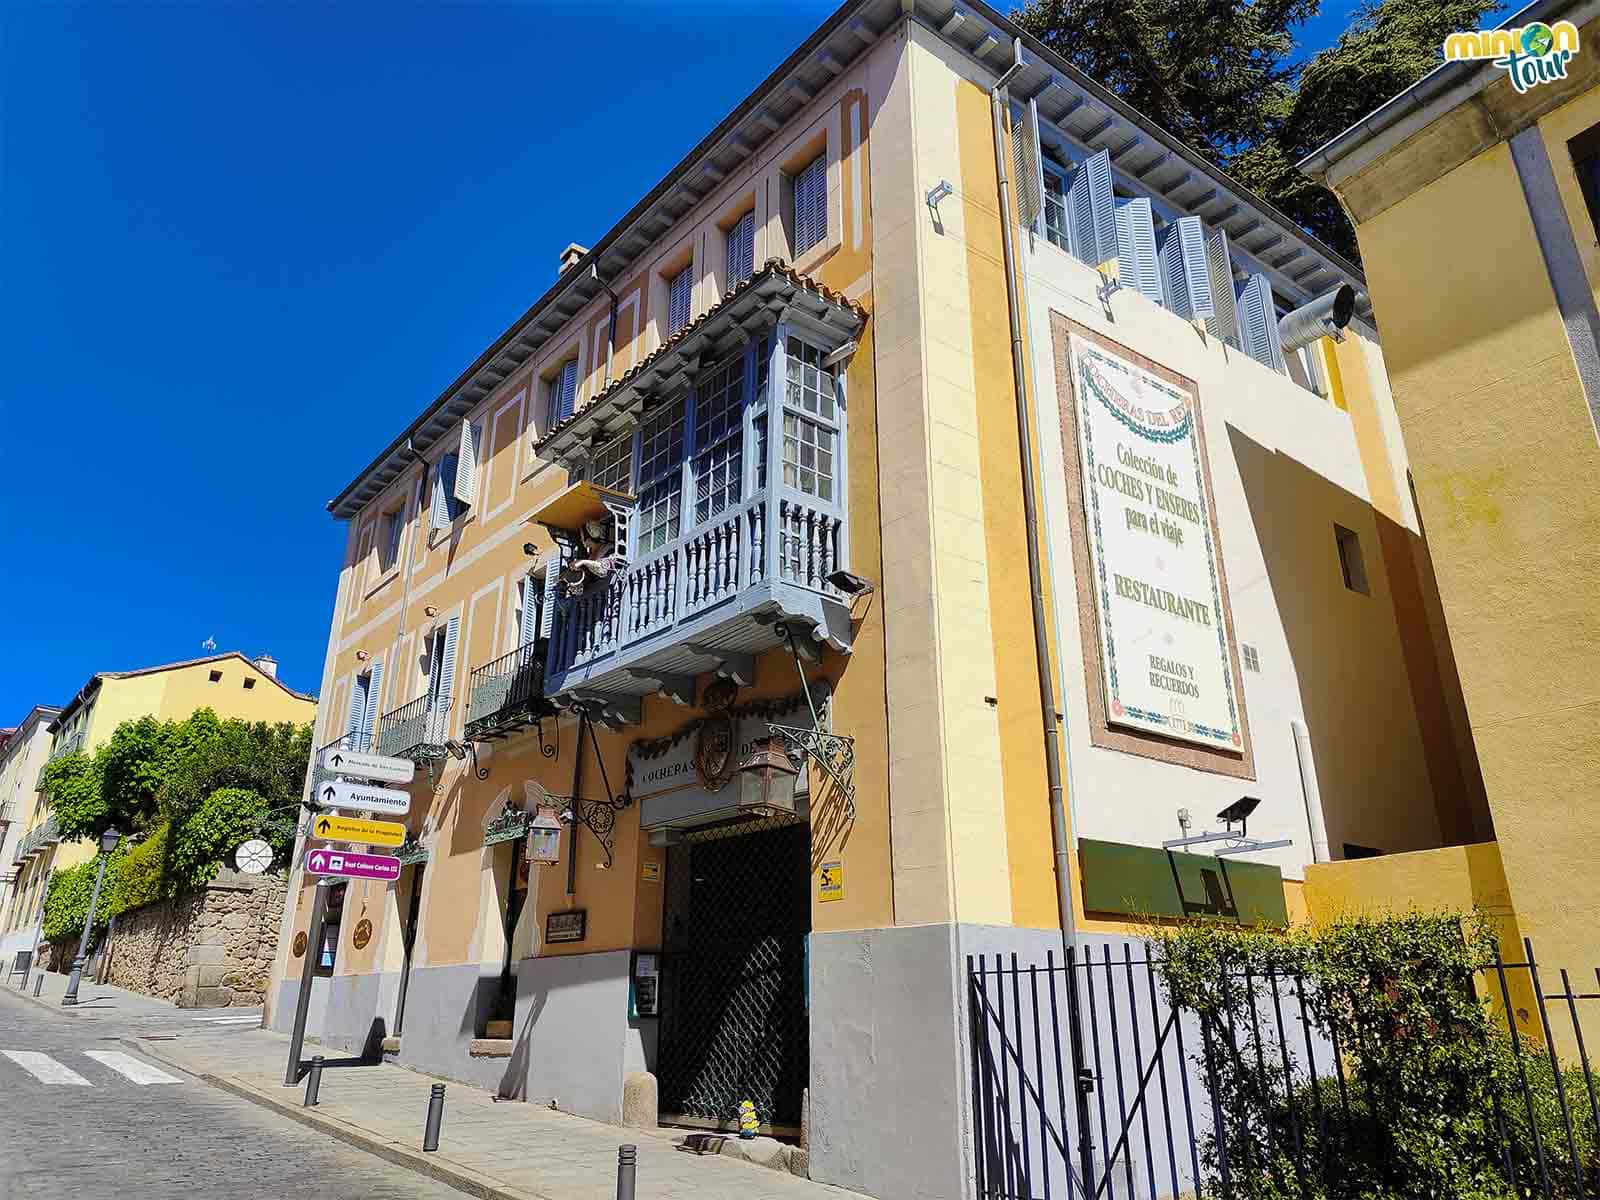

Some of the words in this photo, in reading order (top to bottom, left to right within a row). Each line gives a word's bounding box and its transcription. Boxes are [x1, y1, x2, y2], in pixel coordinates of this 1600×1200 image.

[1116, 441, 1165, 483] Colección
[1166, 463, 1179, 488] de
[1097, 462, 1145, 502] COCHES
[1144, 481, 1153, 505] Y
[1155, 486, 1200, 525] ENSERES
[1125, 506, 1149, 533] para
[1150, 511, 1160, 537] el
[1160, 516, 1185, 551] viaje
[1112, 572, 1211, 626] RESTAURANTE
[1148, 671, 1200, 700] RECUERDOS
[1149, 653, 1187, 680] REGALOS
[1186, 665, 1195, 681] Y
[349, 792, 407, 808] Ayuntamiento
